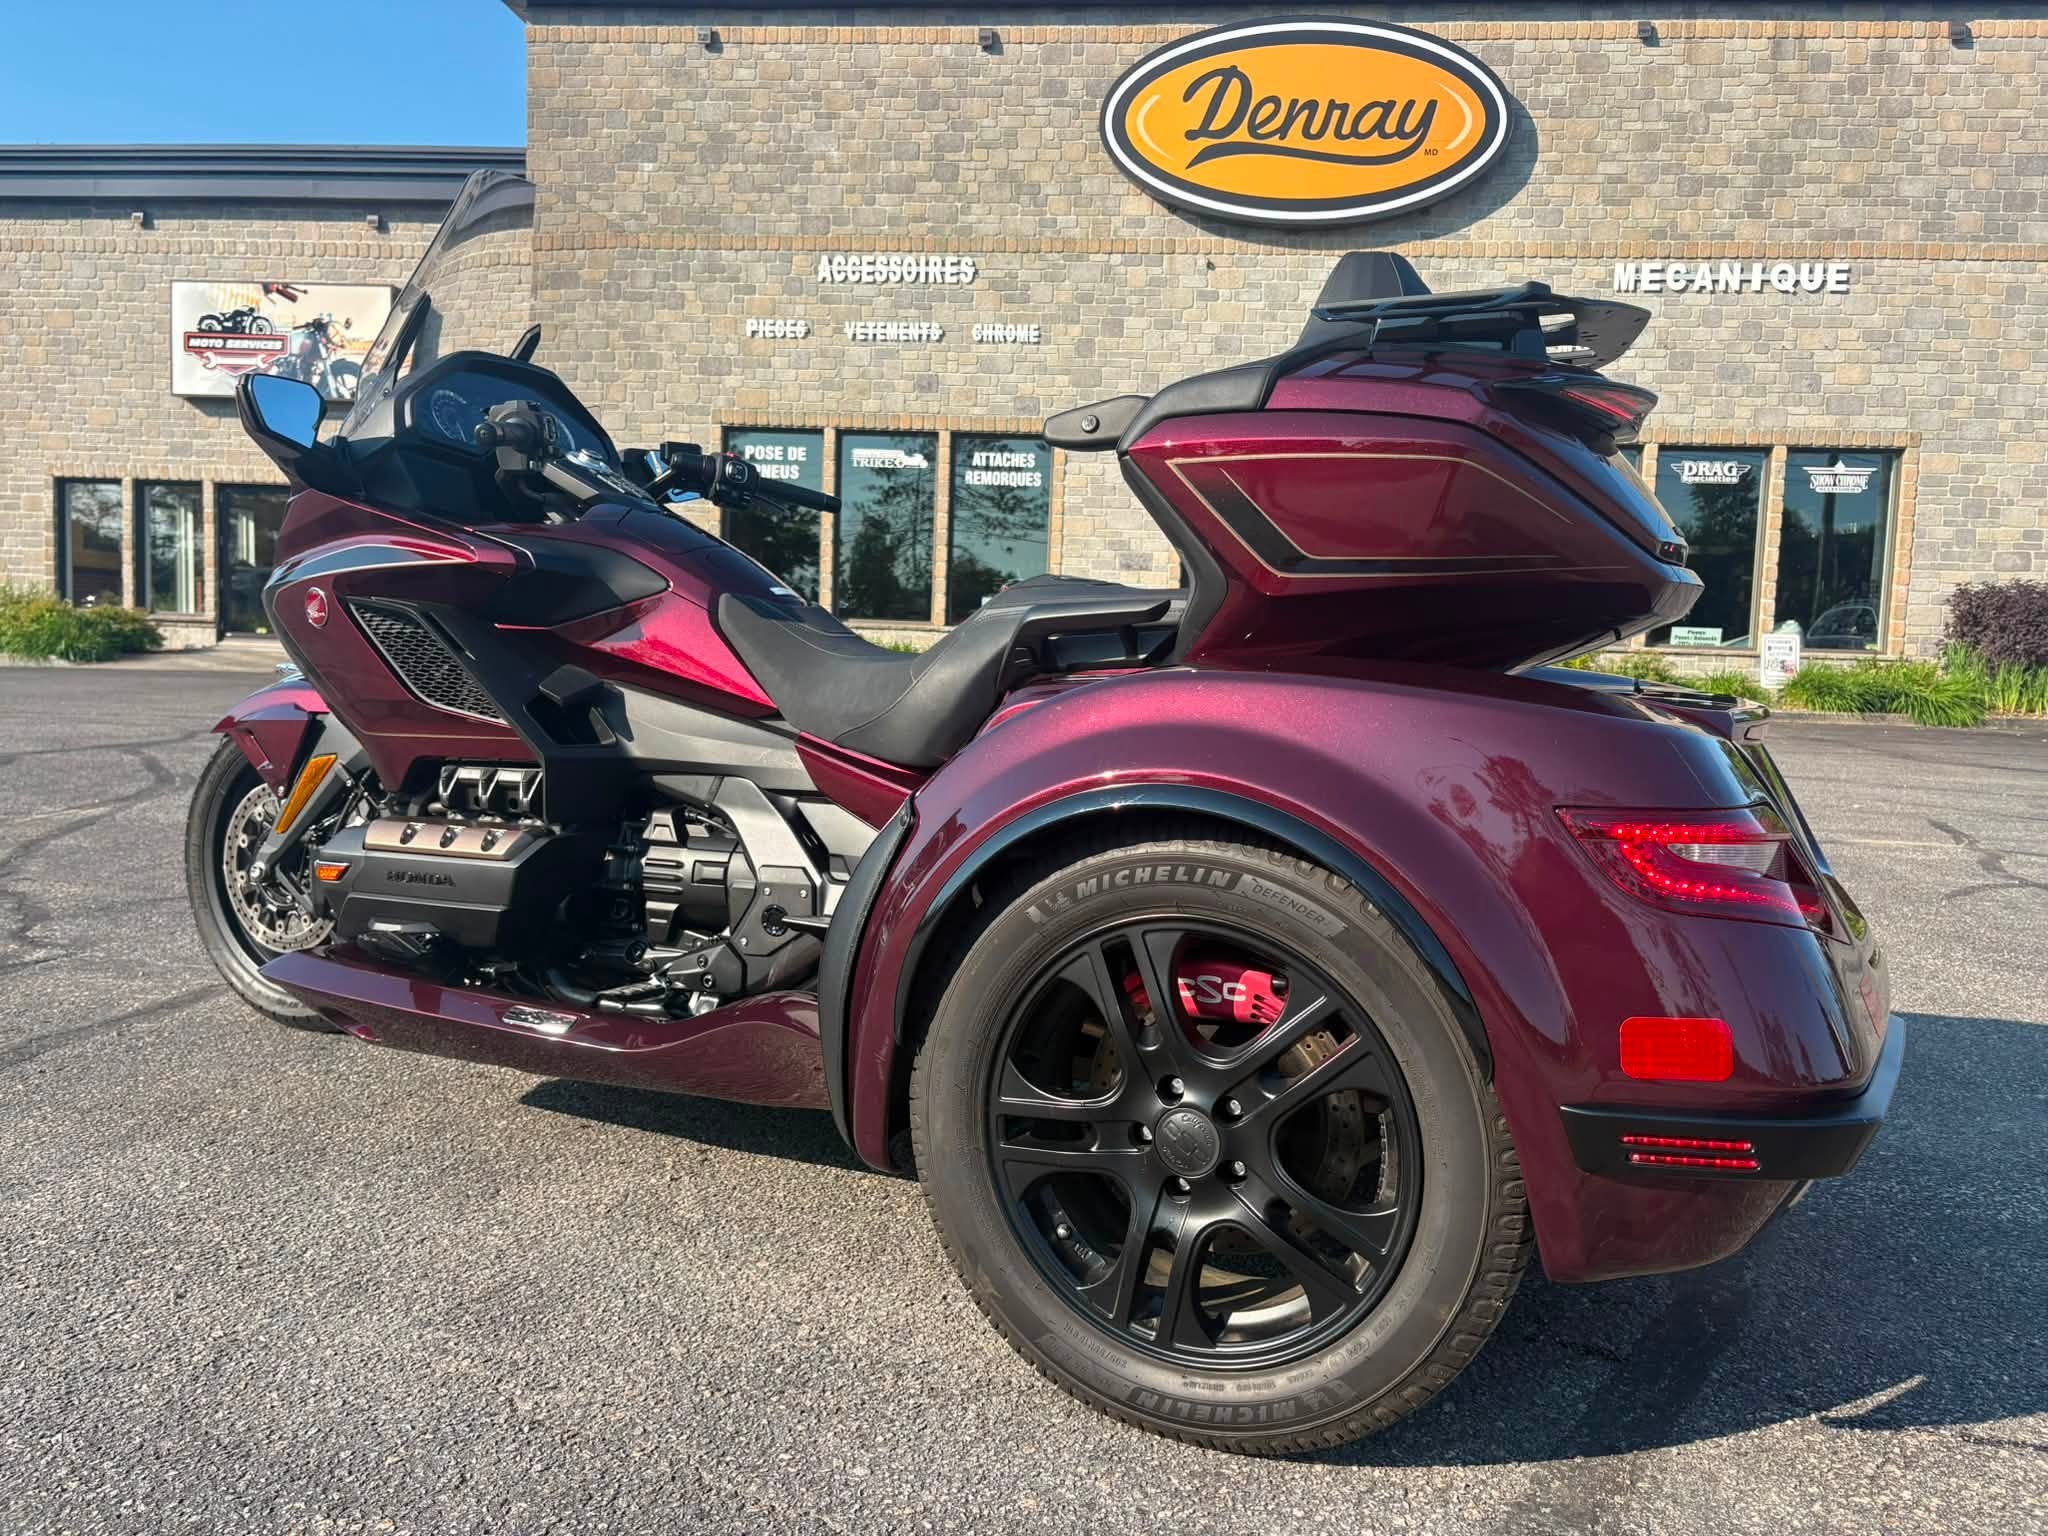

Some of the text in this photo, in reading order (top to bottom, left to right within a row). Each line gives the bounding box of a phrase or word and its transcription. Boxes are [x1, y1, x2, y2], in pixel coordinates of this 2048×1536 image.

[1183, 64, 1439, 169] Denray
[1423, 147, 1439, 157] MD
[817, 254, 976, 284] ACCESSOIRES
[1613, 262, 1850, 292] MECANIQUE
[745, 318, 1040, 344] PIECES VETEMENTS CHROME
[188, 337, 283, 350] MOTO SERVICES
[744, 445, 807, 461] POSE DE
[971, 452, 1035, 468] ATTACHES
[1684, 462, 1738, 476] DRAG
[965, 471, 1042, 487] REMORQUES
[1810, 474, 1869, 489] SHOW CHROME
[1076, 865, 1232, 900] MICHELIN
[1135, 1390, 1297, 1425] MICHELIN
